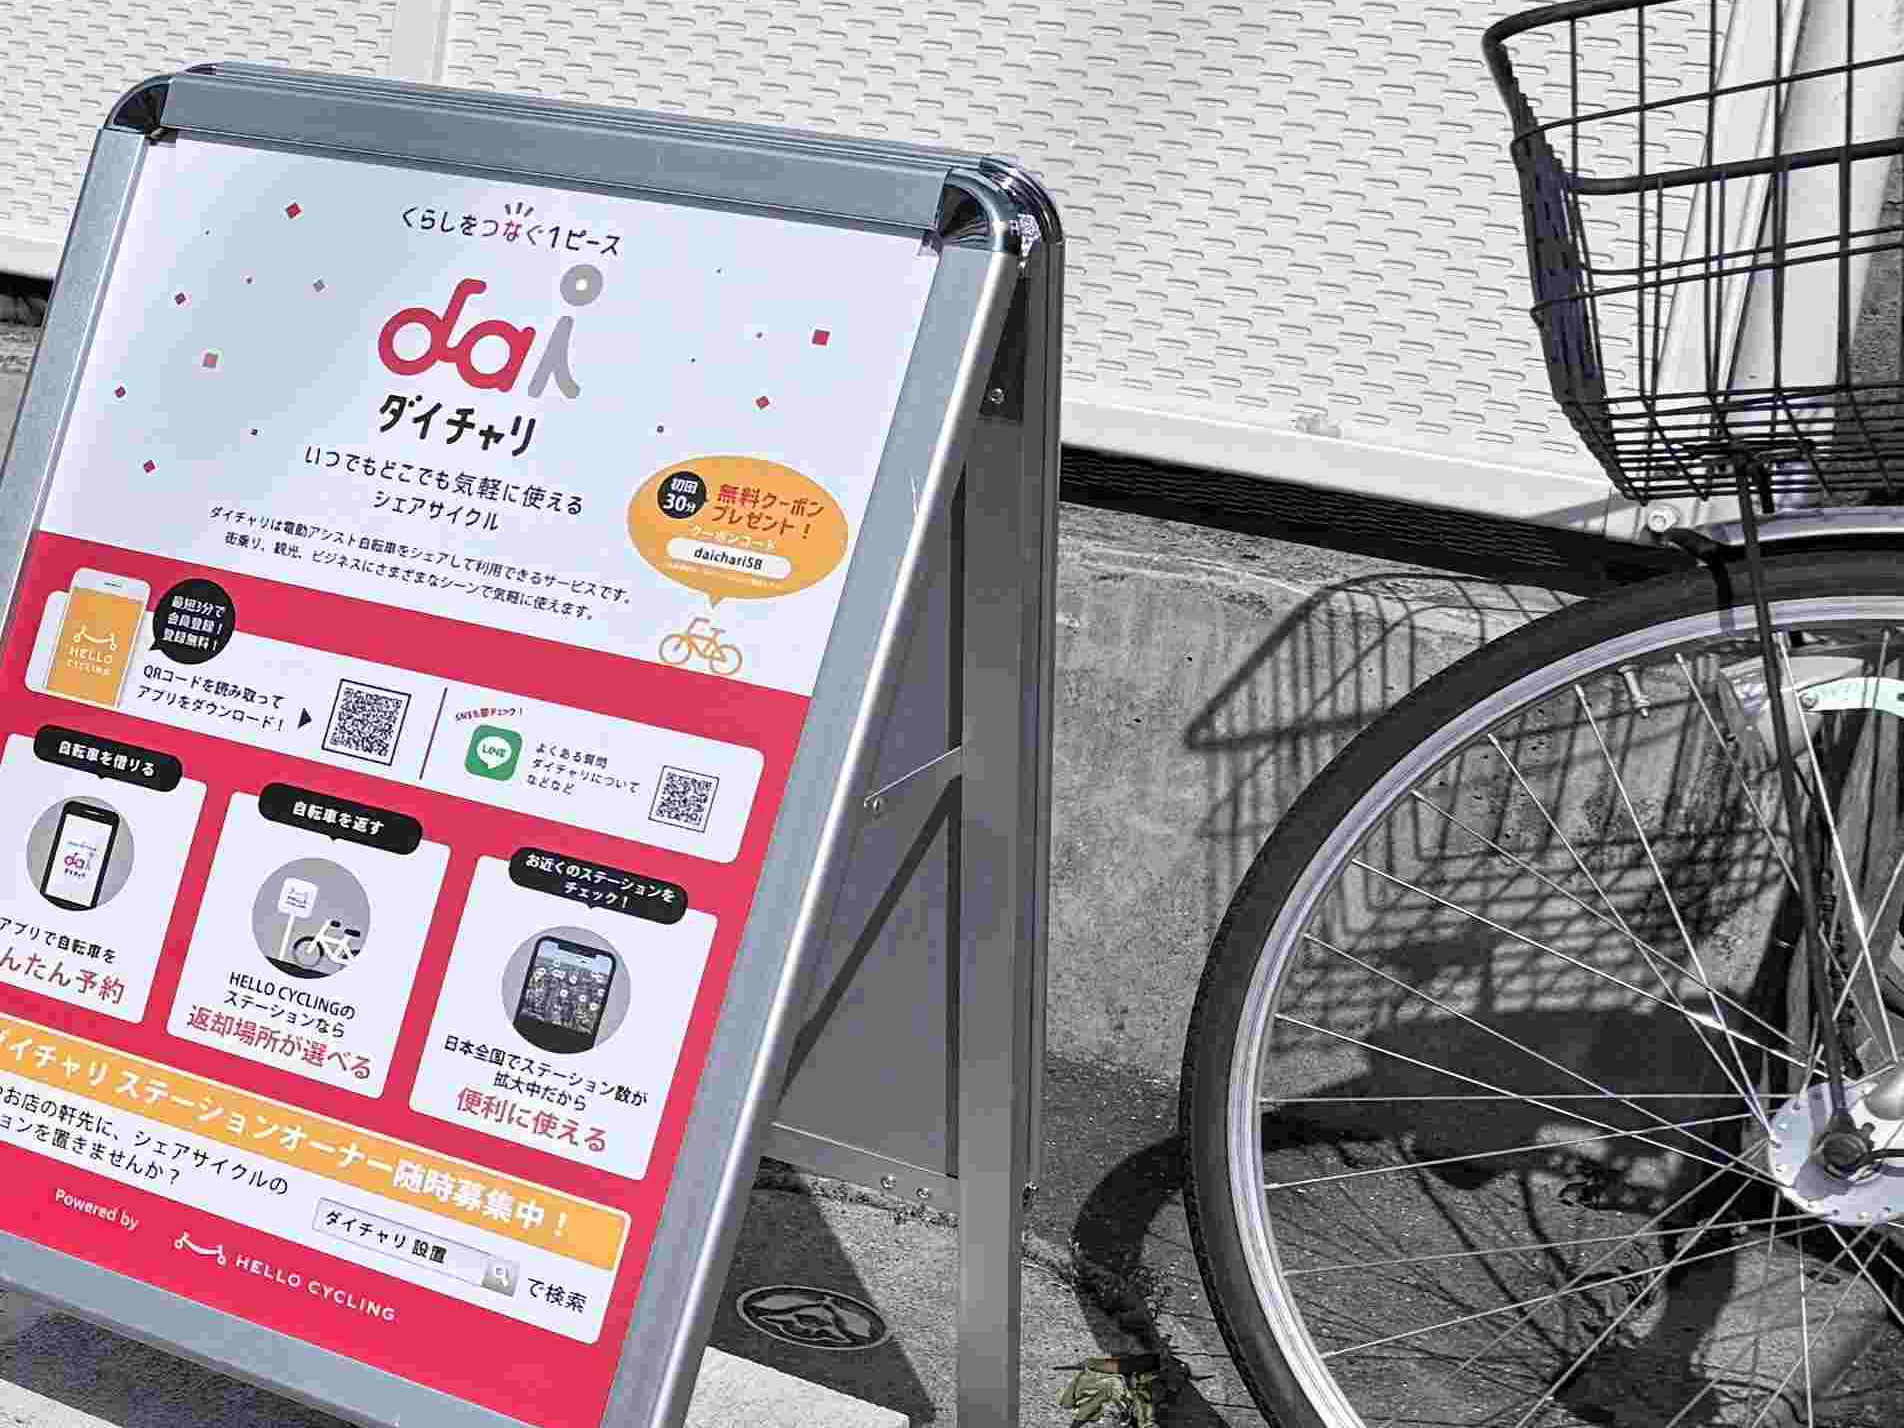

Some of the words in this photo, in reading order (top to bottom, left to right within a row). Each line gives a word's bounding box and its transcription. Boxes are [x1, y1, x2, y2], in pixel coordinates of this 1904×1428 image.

[402, 206, 621, 256] くらしをつなぐ1ピース
[377, 263, 604, 399] dai
[379, 393, 537, 457] ダイチャリ
[305, 445, 585, 516] いつでもどこでも気軽に使える
[717, 483, 824, 518] 無料クーポン
[372, 490, 501, 532] シェアサイクル
[143, 663, 286, 709] QRコードを読み取って
[58, 740, 155, 777] 自転車を借りる
[482, 743, 507, 759] LINE
[535, 743, 609, 769] よくある質問
[526, 774, 576, 796] などなど
[531, 757, 641, 794] ダイチャリについて
[292, 800, 385, 836] 自転車を返す
[525, 854, 675, 903] お近くのステーションを
[223, 991, 345, 1038] ステーションなら
[229, 971, 275, 997] HELLO
[277, 985, 356, 1020] CYCLINGの
[187, 1004, 371, 1080] 返却場所が選べる
[443, 1035, 648, 1107] 日本全国でステーション数が
[493, 1070, 587, 1112] 拡大中だから
[456, 1087, 607, 1152] 便利に使える
[54, 1187, 116, 1223] Powered
[119, 1211, 140, 1232] by
[324, 1209, 407, 1249] ダイチャリ
[412, 1237, 448, 1265] 設置
[235, 1255, 301, 1289] HELLO
[307, 1280, 396, 1322] CYCLING
[527, 1277, 587, 1314] で検索
